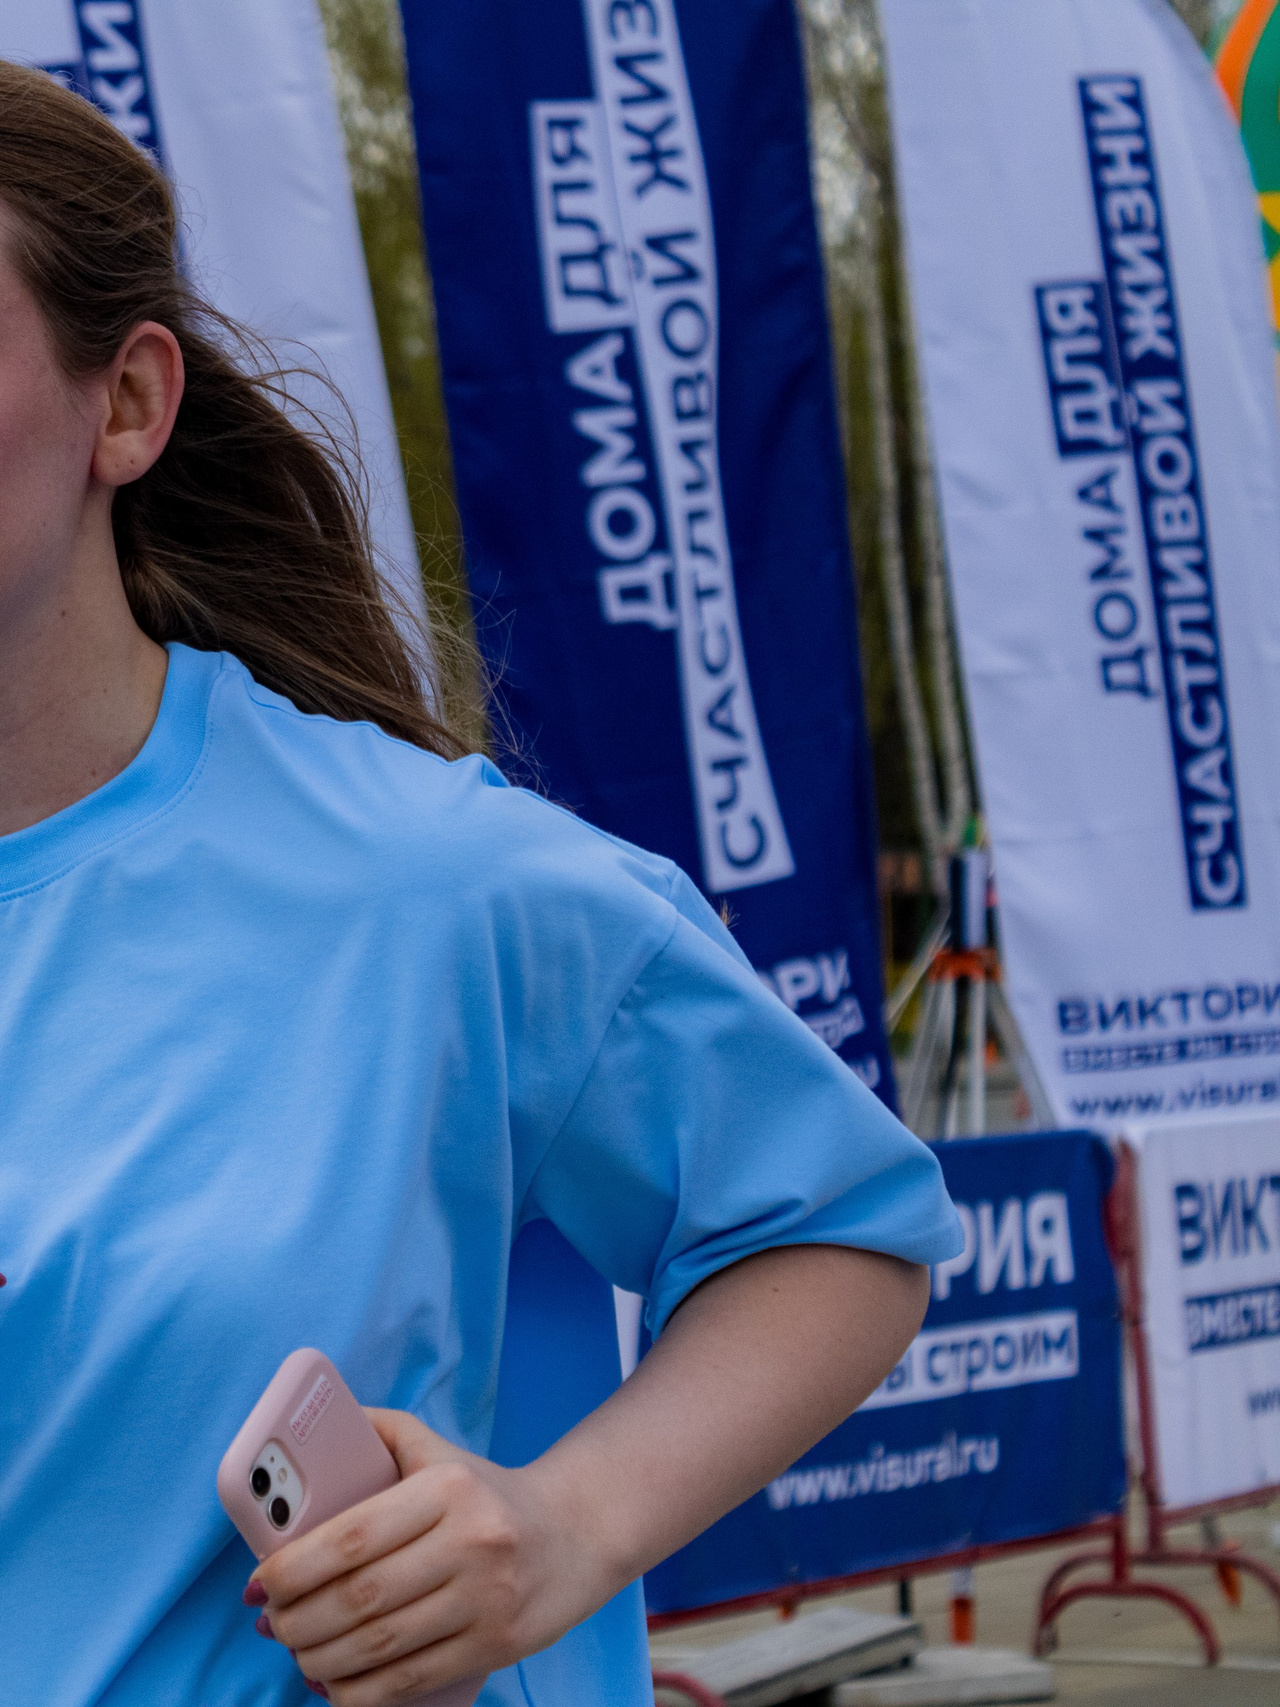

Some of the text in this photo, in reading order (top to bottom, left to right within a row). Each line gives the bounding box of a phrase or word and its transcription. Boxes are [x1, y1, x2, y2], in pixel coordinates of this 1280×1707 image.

[547, 117, 677, 631] ДОМА ДЛЯ
[609, 0, 770, 870] СЧАСТЛИВОЙ ЖИЗ
[1043, 287, 1156, 699] ДОМА ДЛЯ
[1087, 82, 1240, 903] СЧАСТЛИВОЙ ЖИЗНИ
[1057, 980, 1280, 1035] ВИКТОРИ
